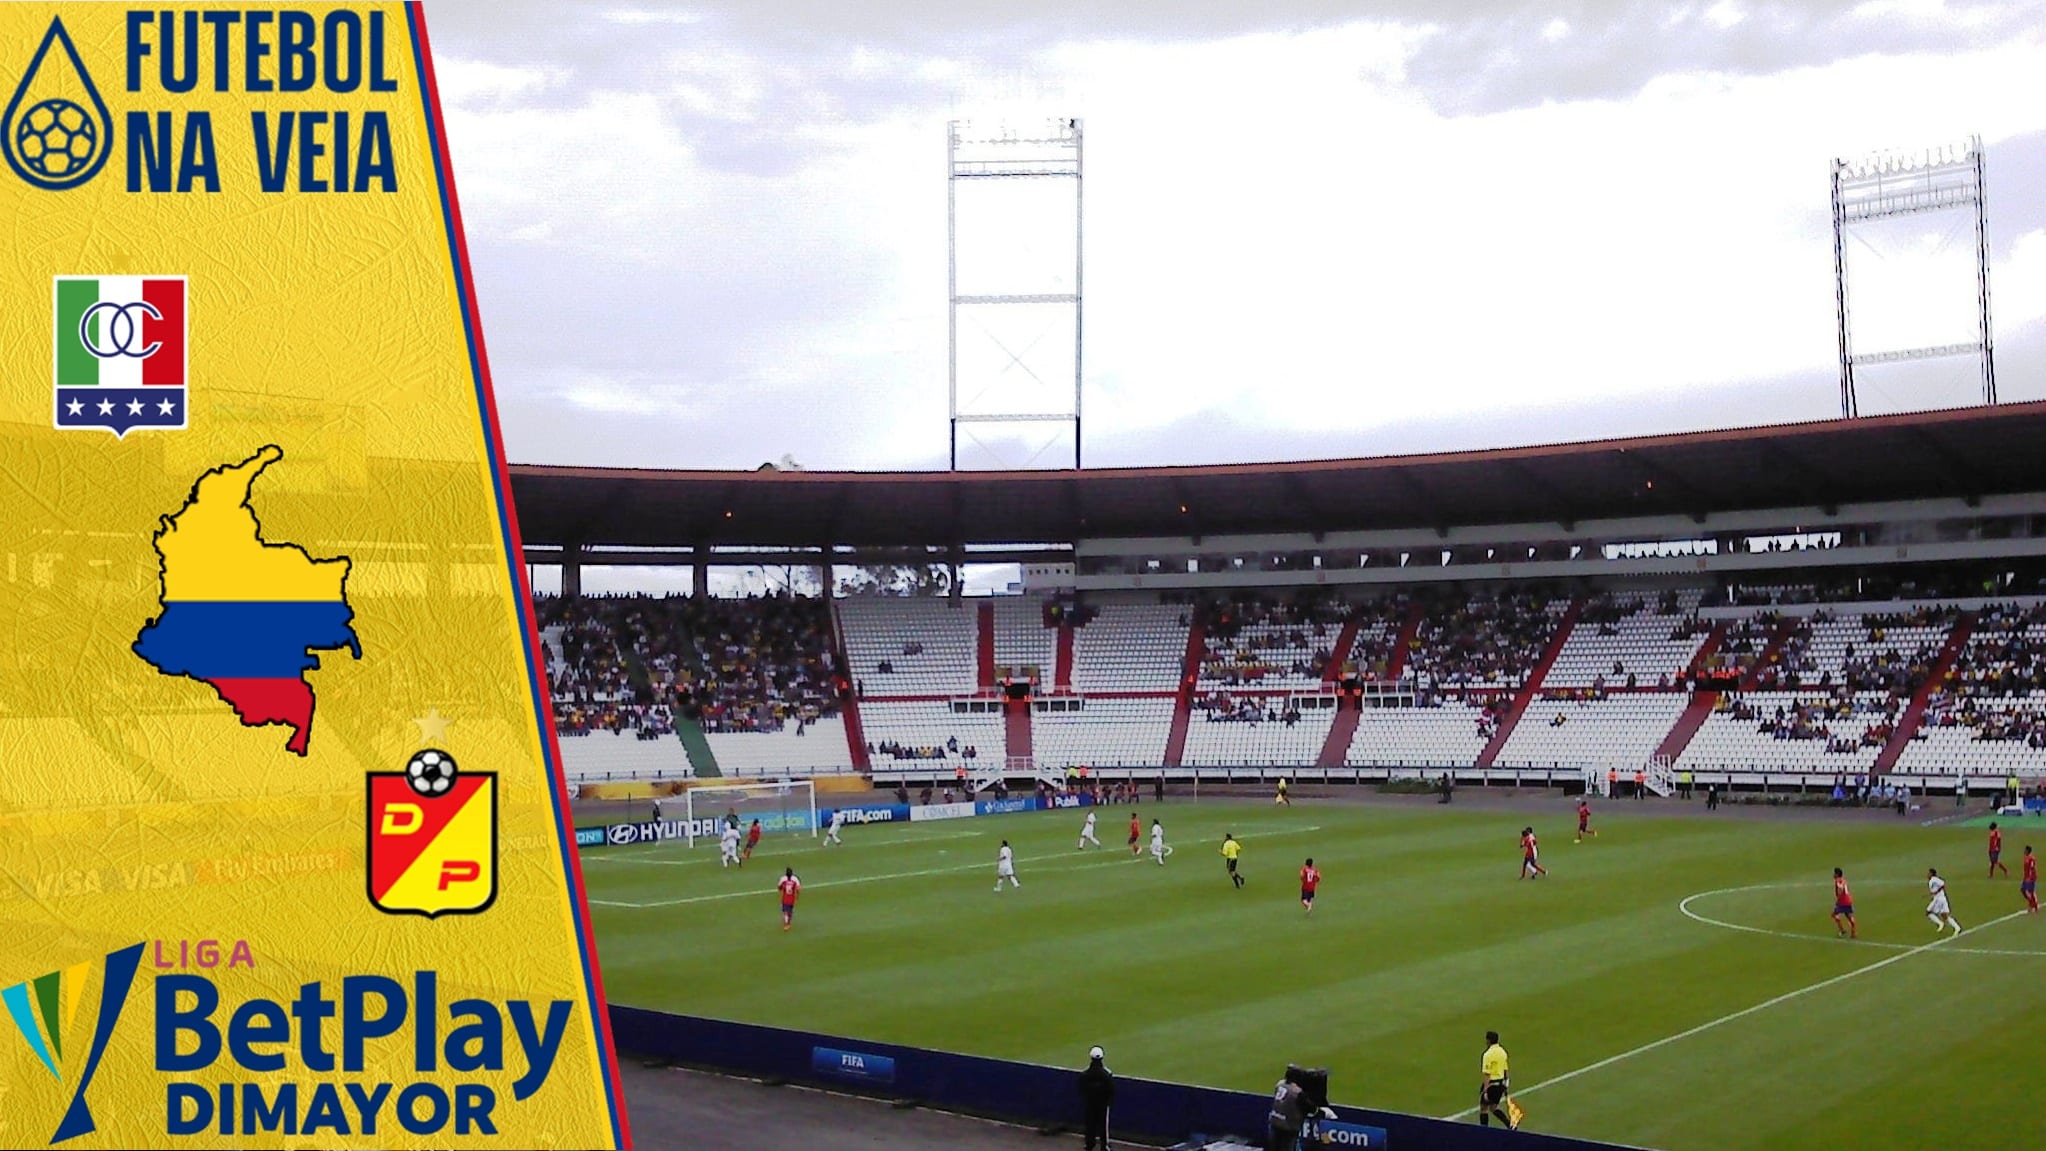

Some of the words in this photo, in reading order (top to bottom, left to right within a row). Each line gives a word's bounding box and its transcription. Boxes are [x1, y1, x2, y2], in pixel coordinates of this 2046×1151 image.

[842, 809, 892, 823] FIFA.com
[640, 817, 719, 841] HYUNDAI
[841, 1053, 865, 1068] FIFA
